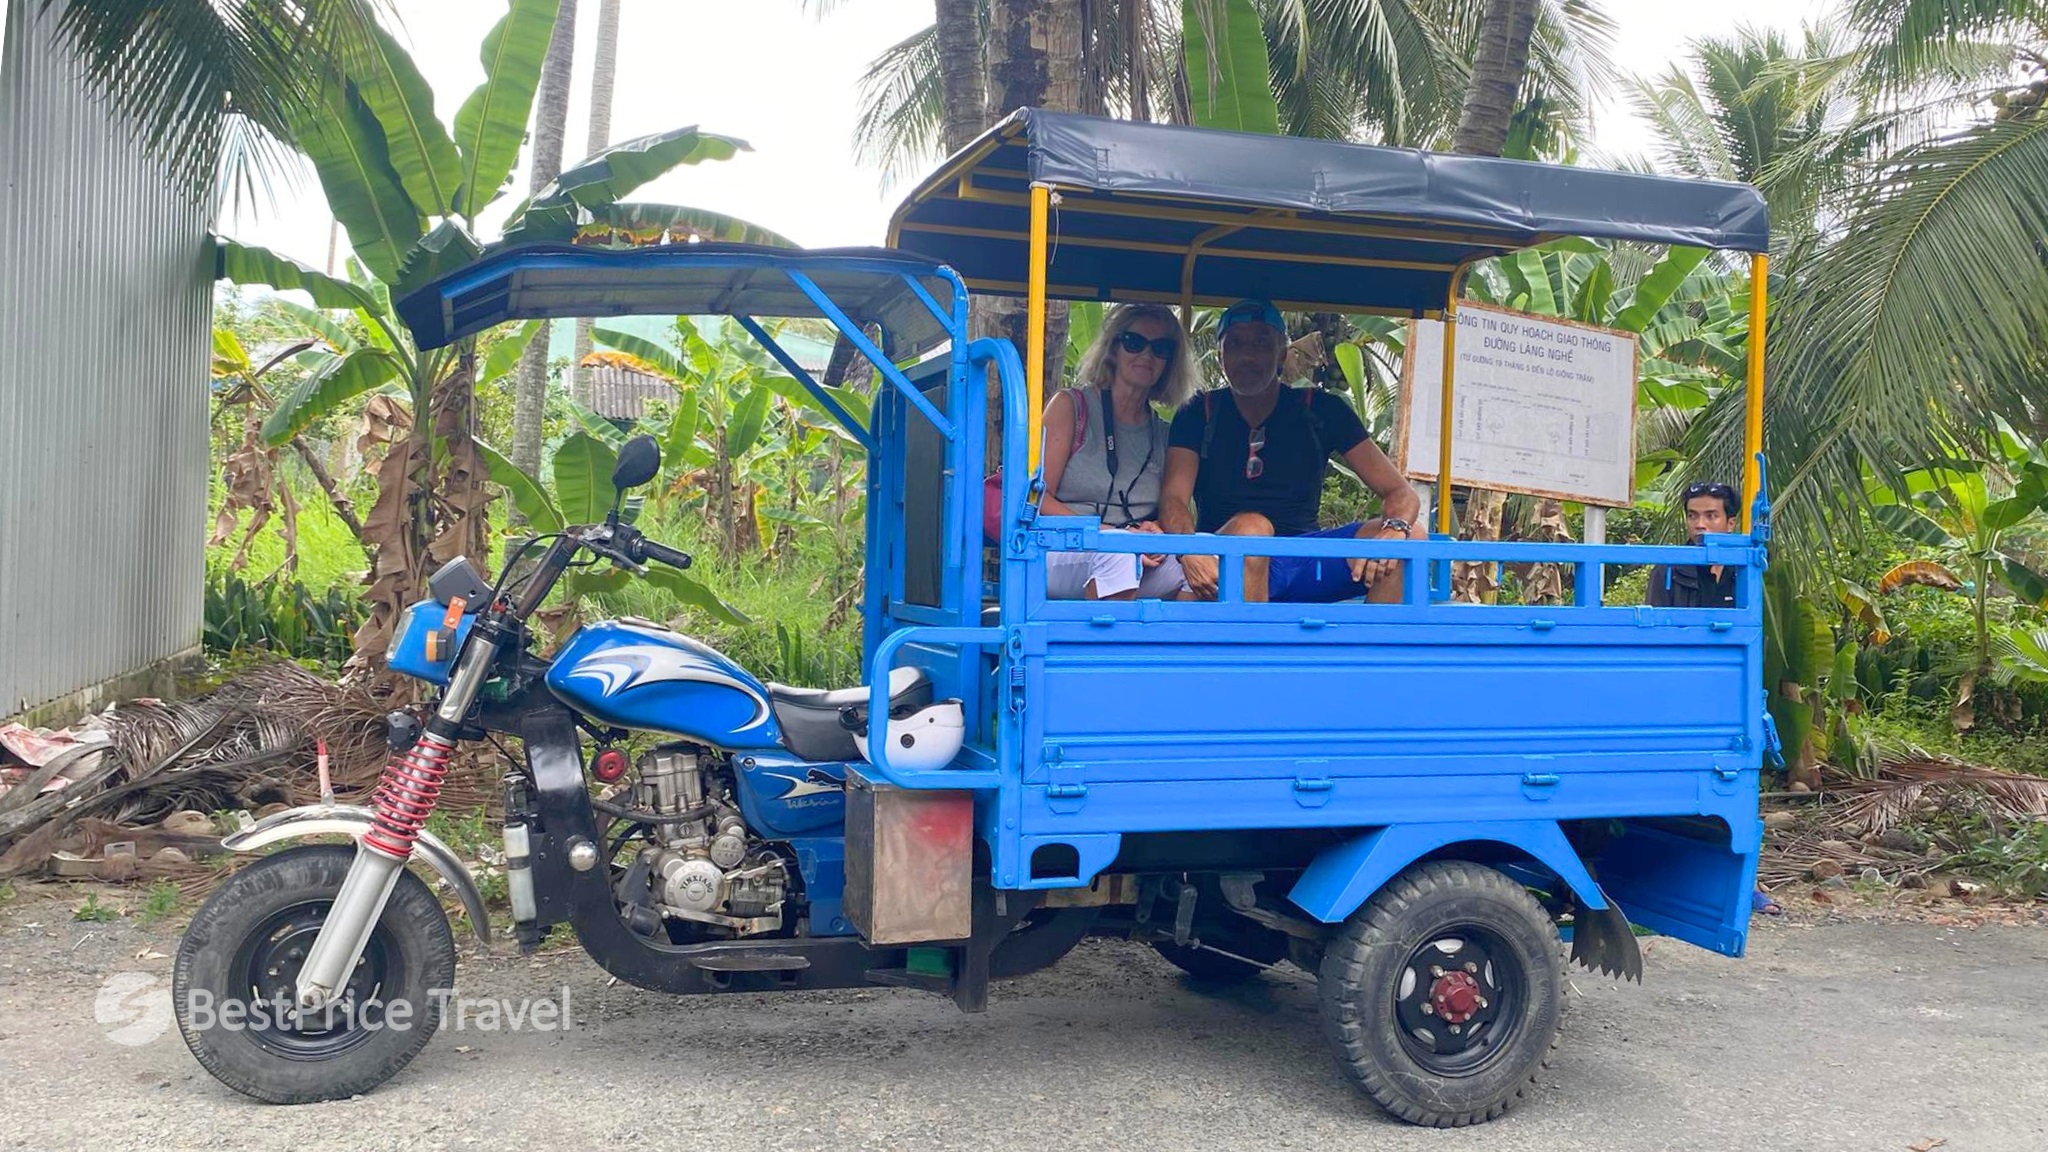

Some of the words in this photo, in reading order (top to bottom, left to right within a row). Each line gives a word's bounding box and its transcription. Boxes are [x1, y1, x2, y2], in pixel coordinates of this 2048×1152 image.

[1457, 312, 1478, 328] ÔNG
[1482, 318, 1497, 331] TIN
[1500, 322, 1519, 335] QUY
[1556, 332, 1578, 347] GIAO
[1581, 337, 1611, 353] THÔNG
[1484, 336, 1516, 353] ĐƯỜNG
[1520, 342, 1545, 358] LÀNG
[680, 875, 714, 893] YINXIANG
